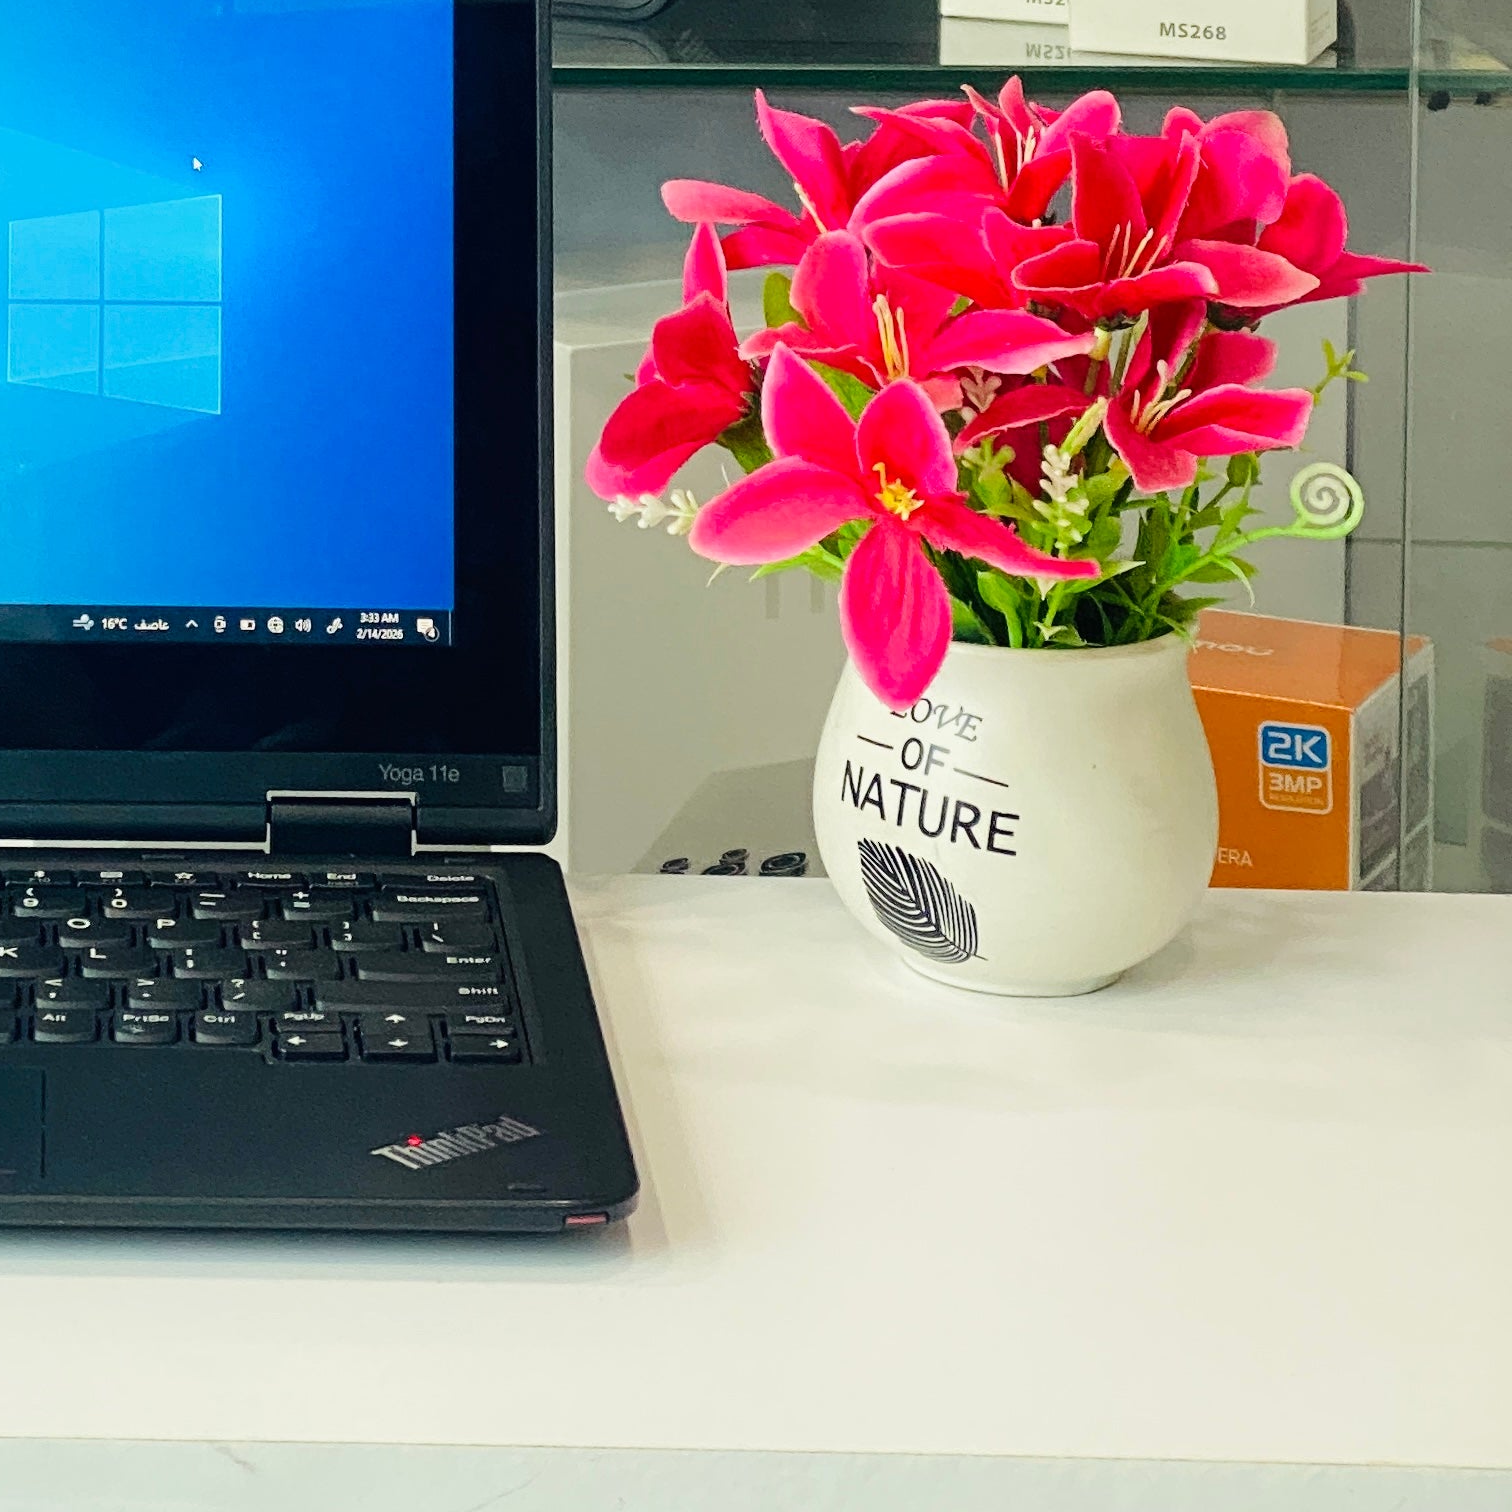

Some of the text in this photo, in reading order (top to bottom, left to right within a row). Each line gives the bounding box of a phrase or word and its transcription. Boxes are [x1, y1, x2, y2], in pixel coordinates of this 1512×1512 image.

[1160, 23, 1227, 41] MS268
[102, 617, 127, 630] 16°C
[381, 613, 399, 624] AM
[901, 737, 951, 776] OF
[1267, 730, 1322, 764] 2K
[379, 763, 460, 784] Yoga 11e
[1269, 772, 1323, 794] 3MP
[841, 759, 1020, 856] NATURE
[156, 918, 176, 930] P
[90, 948, 107, 959] L
[369, 1115, 541, 1170] ThinkPad
